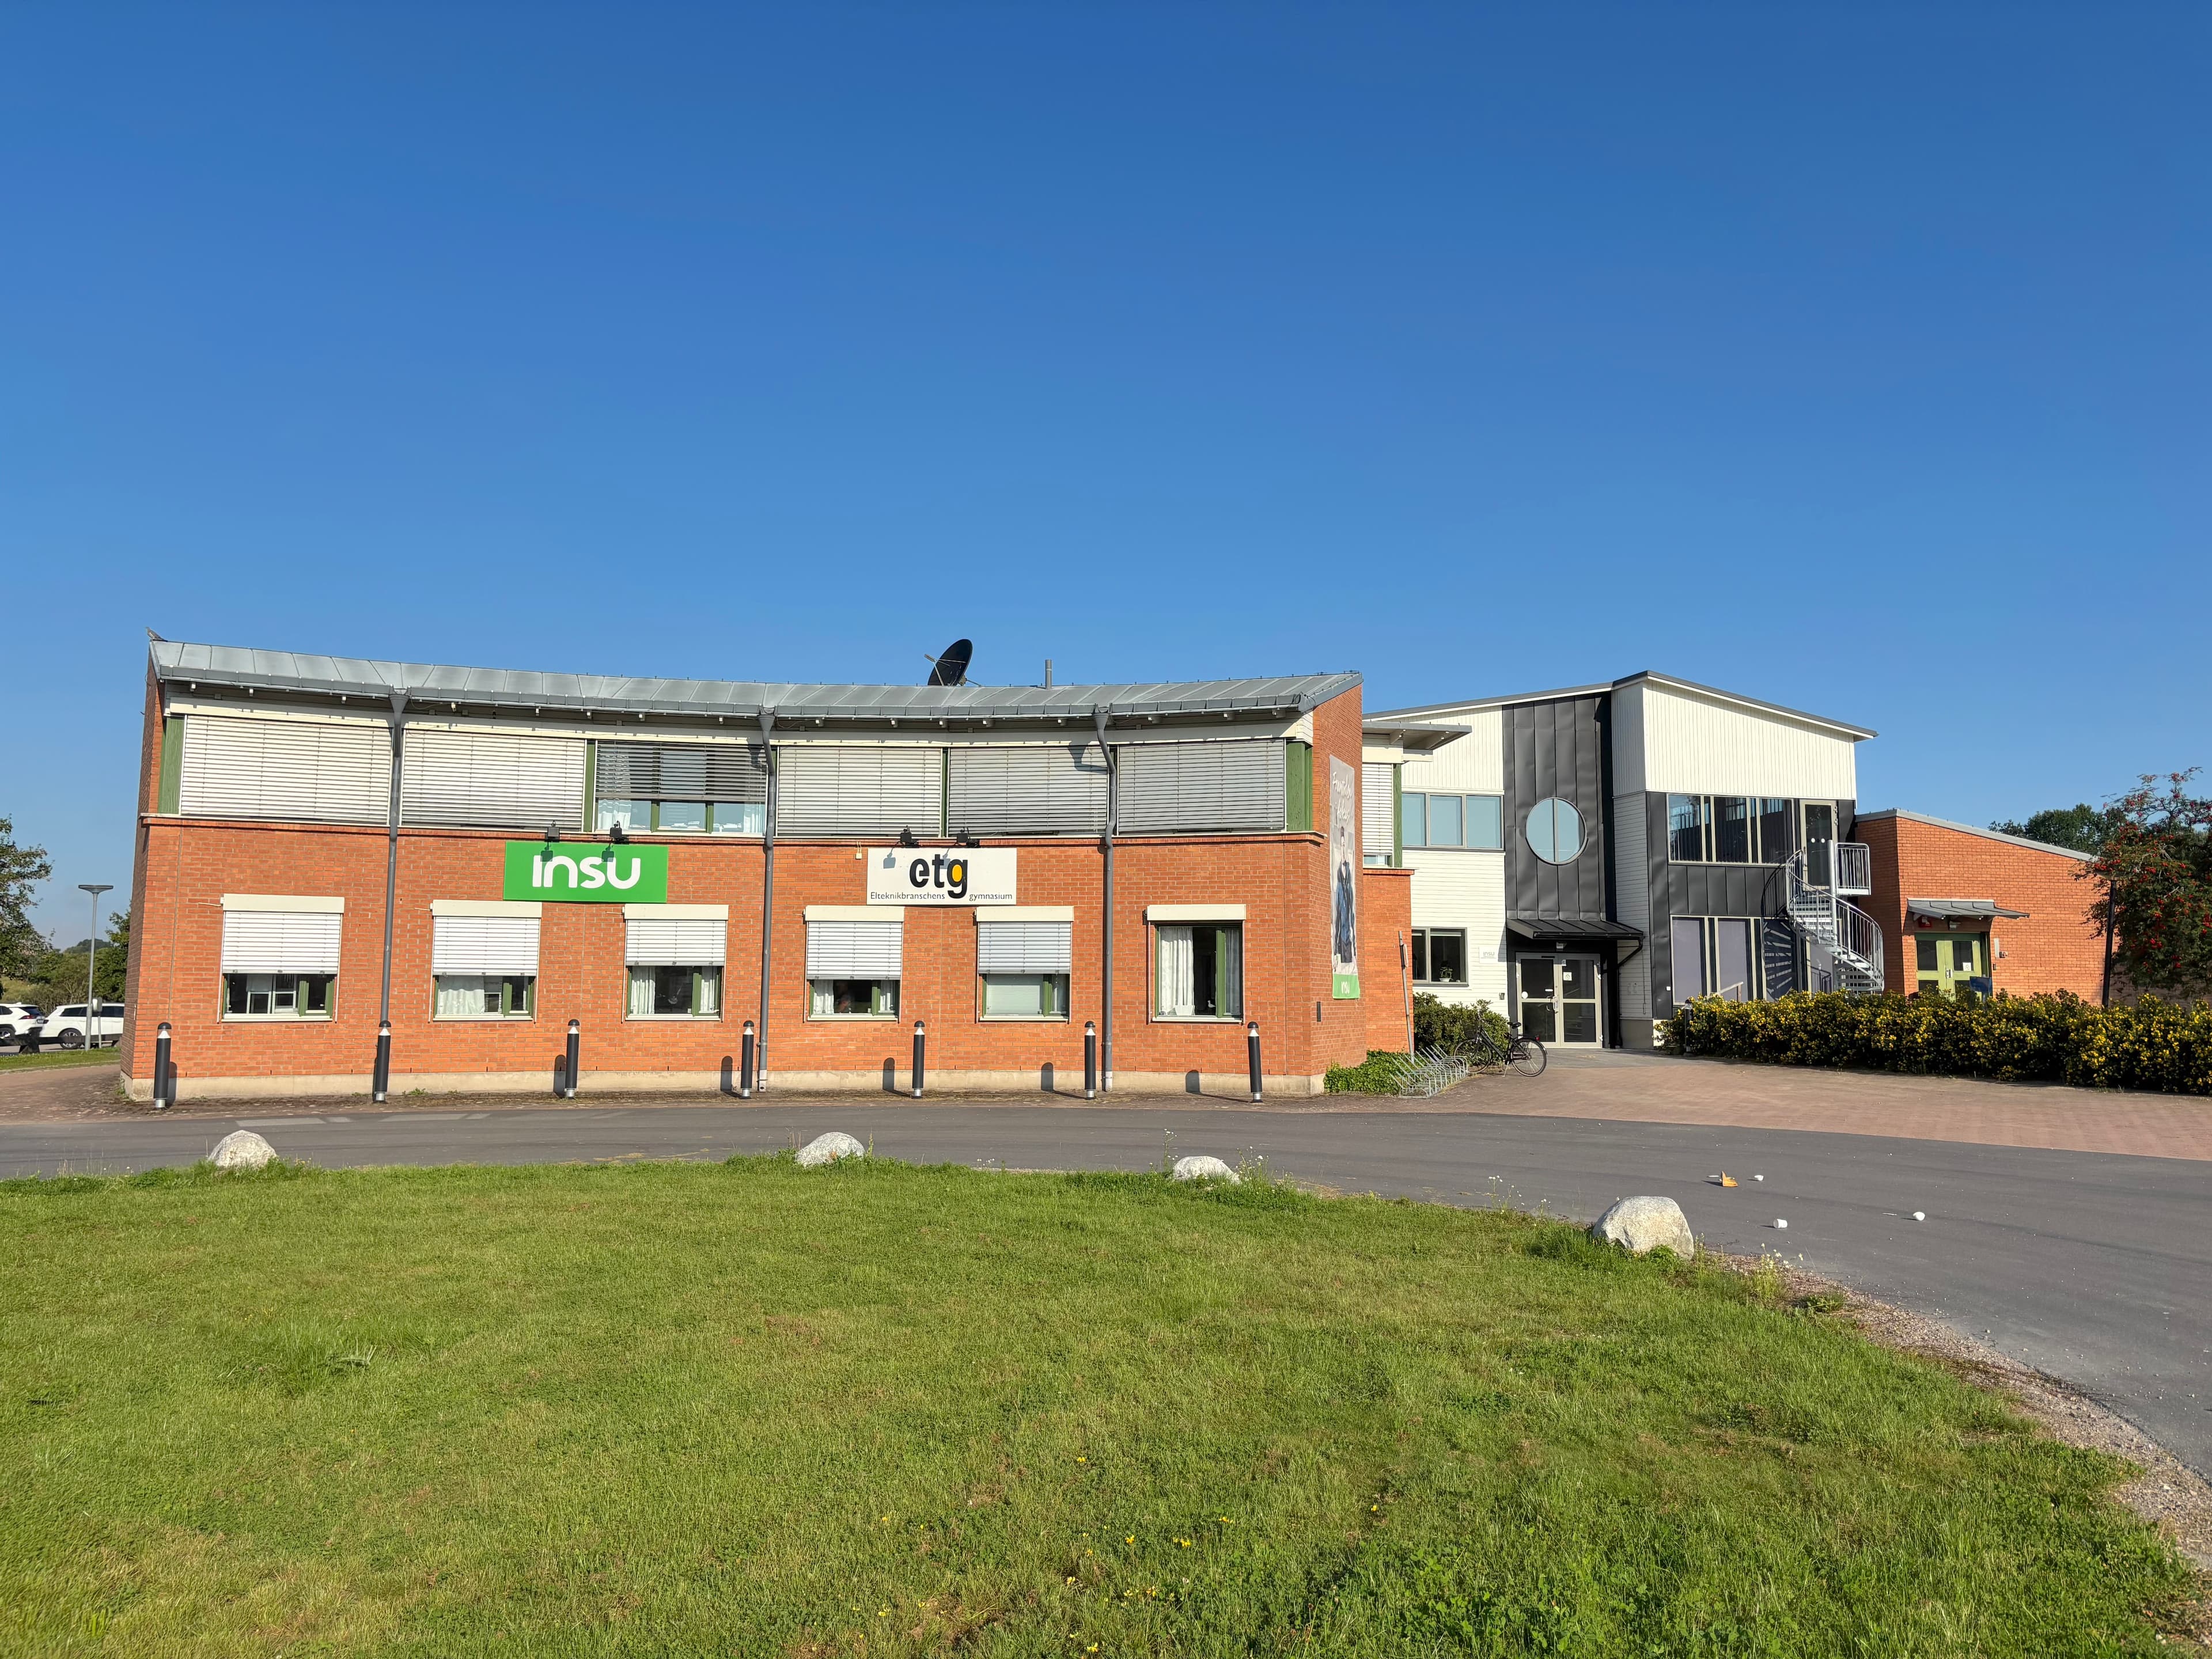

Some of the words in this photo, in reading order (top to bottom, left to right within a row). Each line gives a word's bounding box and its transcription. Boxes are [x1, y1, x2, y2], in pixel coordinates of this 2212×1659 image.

[910, 854, 968, 899] etg
[870, 892, 945, 900] Elteknikbranschens
[969, 893, 1013, 902] gymnasium
